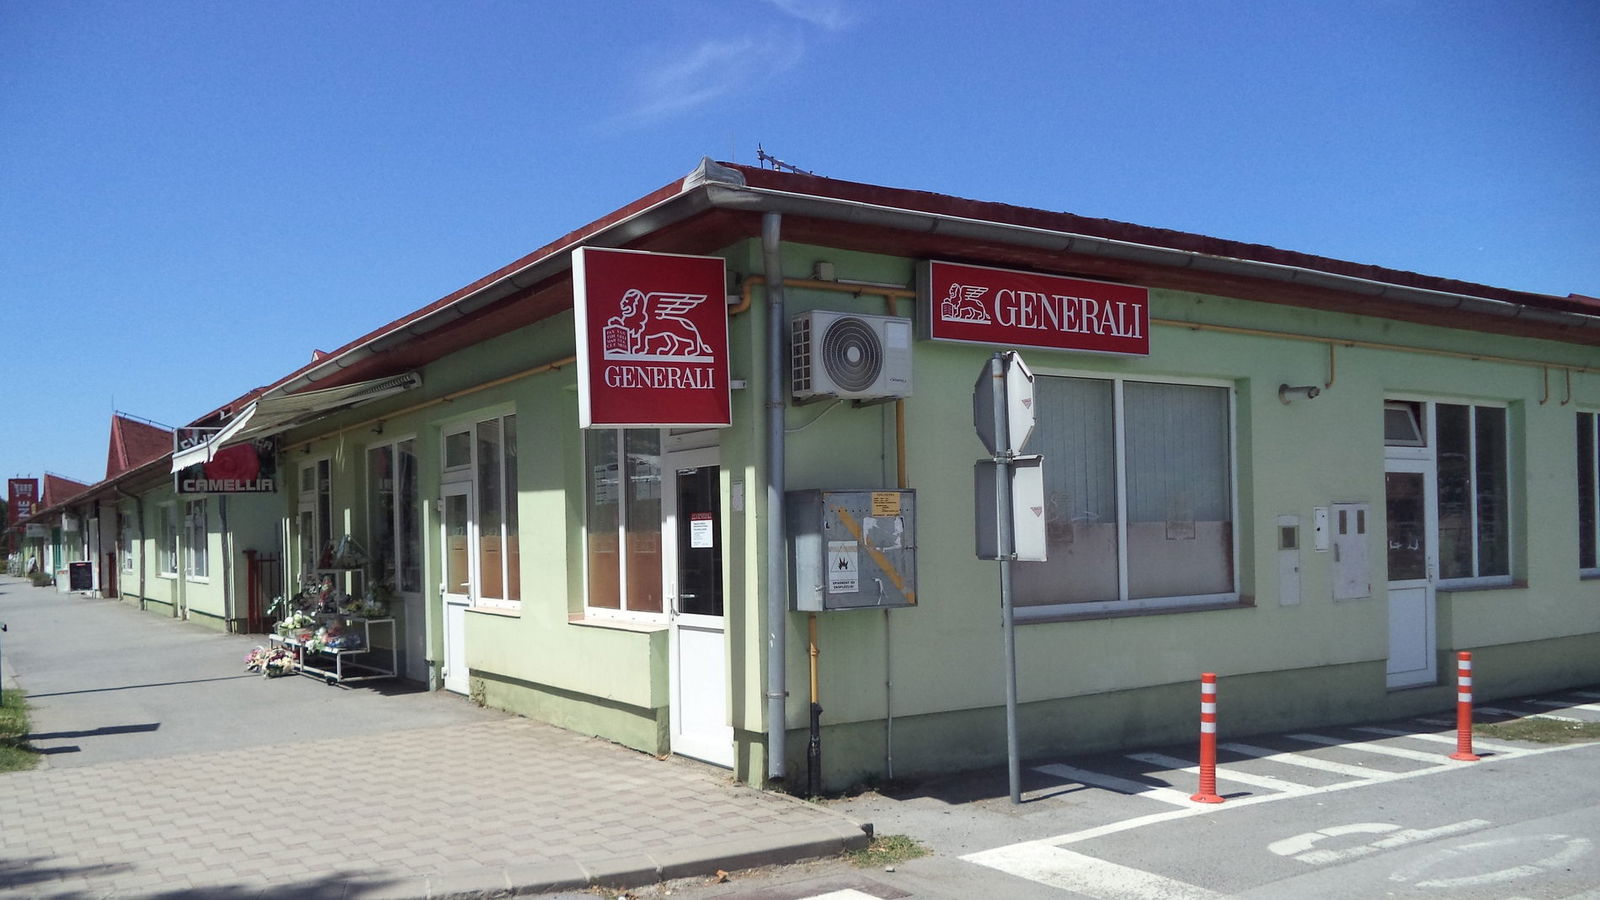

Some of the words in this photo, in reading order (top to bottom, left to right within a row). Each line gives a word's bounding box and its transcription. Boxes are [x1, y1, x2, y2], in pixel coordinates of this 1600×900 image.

[993, 288, 1144, 339] GENERALI
[604, 365, 716, 390] GENERALI
[183, 478, 274, 492] CAMELLIA
